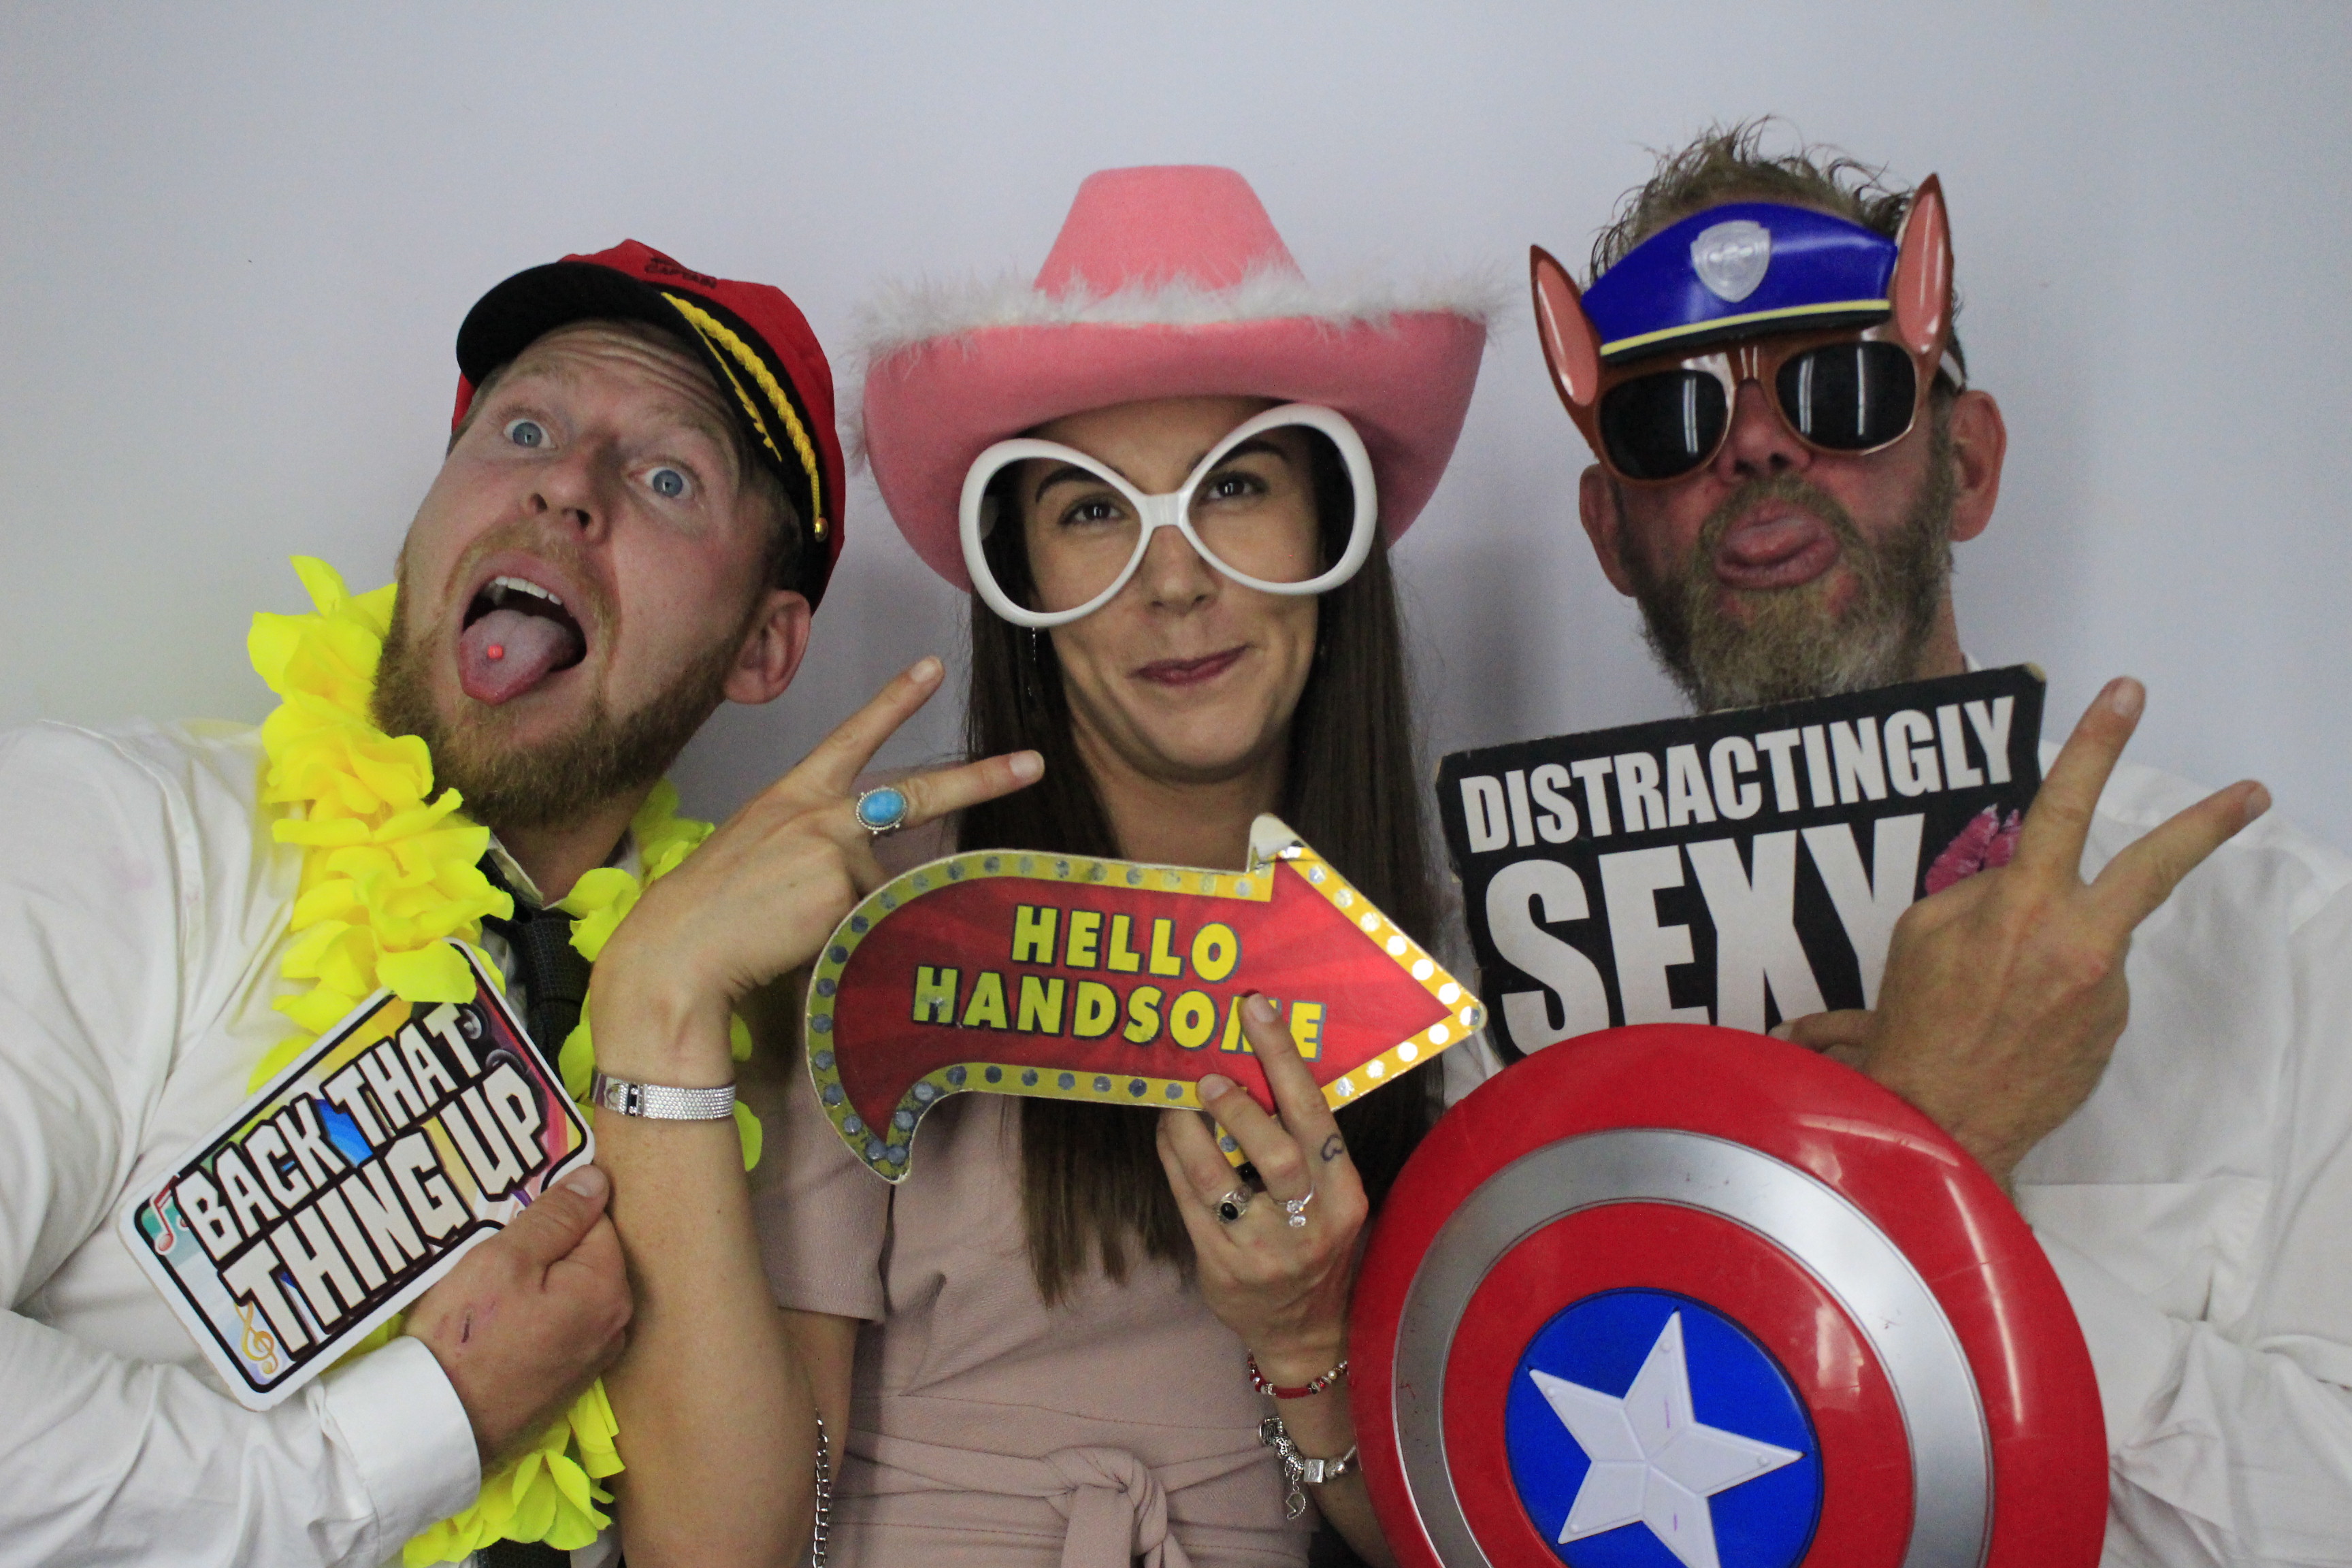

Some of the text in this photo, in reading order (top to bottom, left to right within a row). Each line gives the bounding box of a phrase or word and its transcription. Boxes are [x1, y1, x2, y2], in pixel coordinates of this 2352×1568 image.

[1459, 696, 2015, 854] DISTRACTINGLY
[1011, 904, 1241, 983] HELLO
[1486, 813, 1925, 1056] SEXY
[174, 1004, 481, 1262] BACK THAT
[220, 1065, 546, 1355] THING UP
